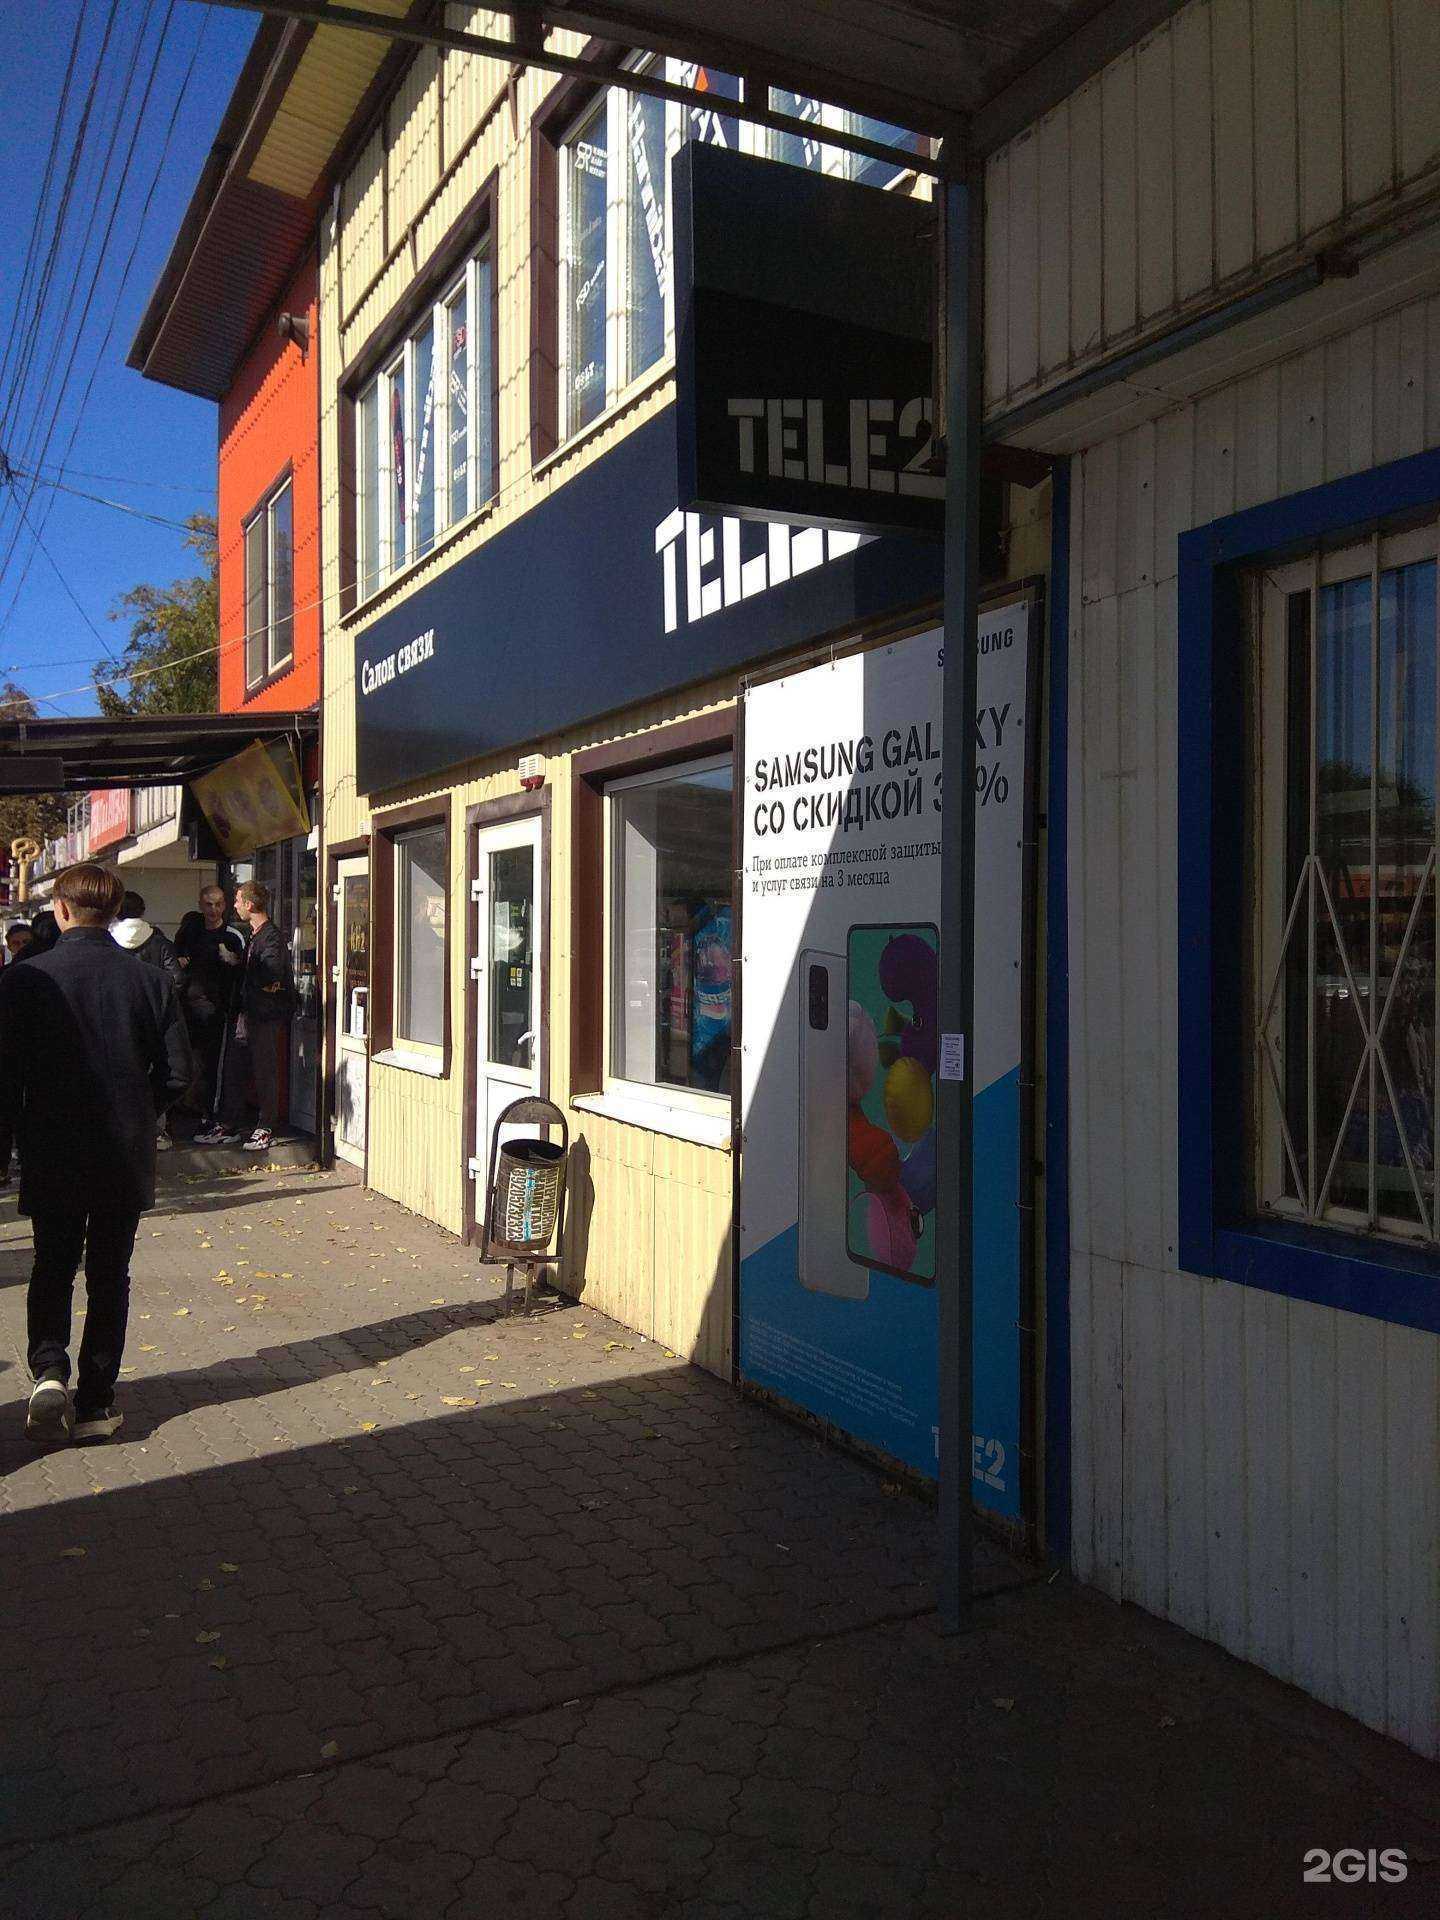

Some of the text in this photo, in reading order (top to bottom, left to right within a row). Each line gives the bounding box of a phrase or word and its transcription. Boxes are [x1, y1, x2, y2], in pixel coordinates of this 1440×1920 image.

[727, 396, 946, 500] TELE2
[361, 628, 434, 696] Салон связи
[754, 735, 874, 792] SAMSUNG
[754, 800, 785, 836] СО
[793, 767, 922, 832] СКИДКОЙ
[752, 840, 942, 876] При оплате комплексной защиты
[752, 869, 890, 897] и услуг связи на 3 месяца
